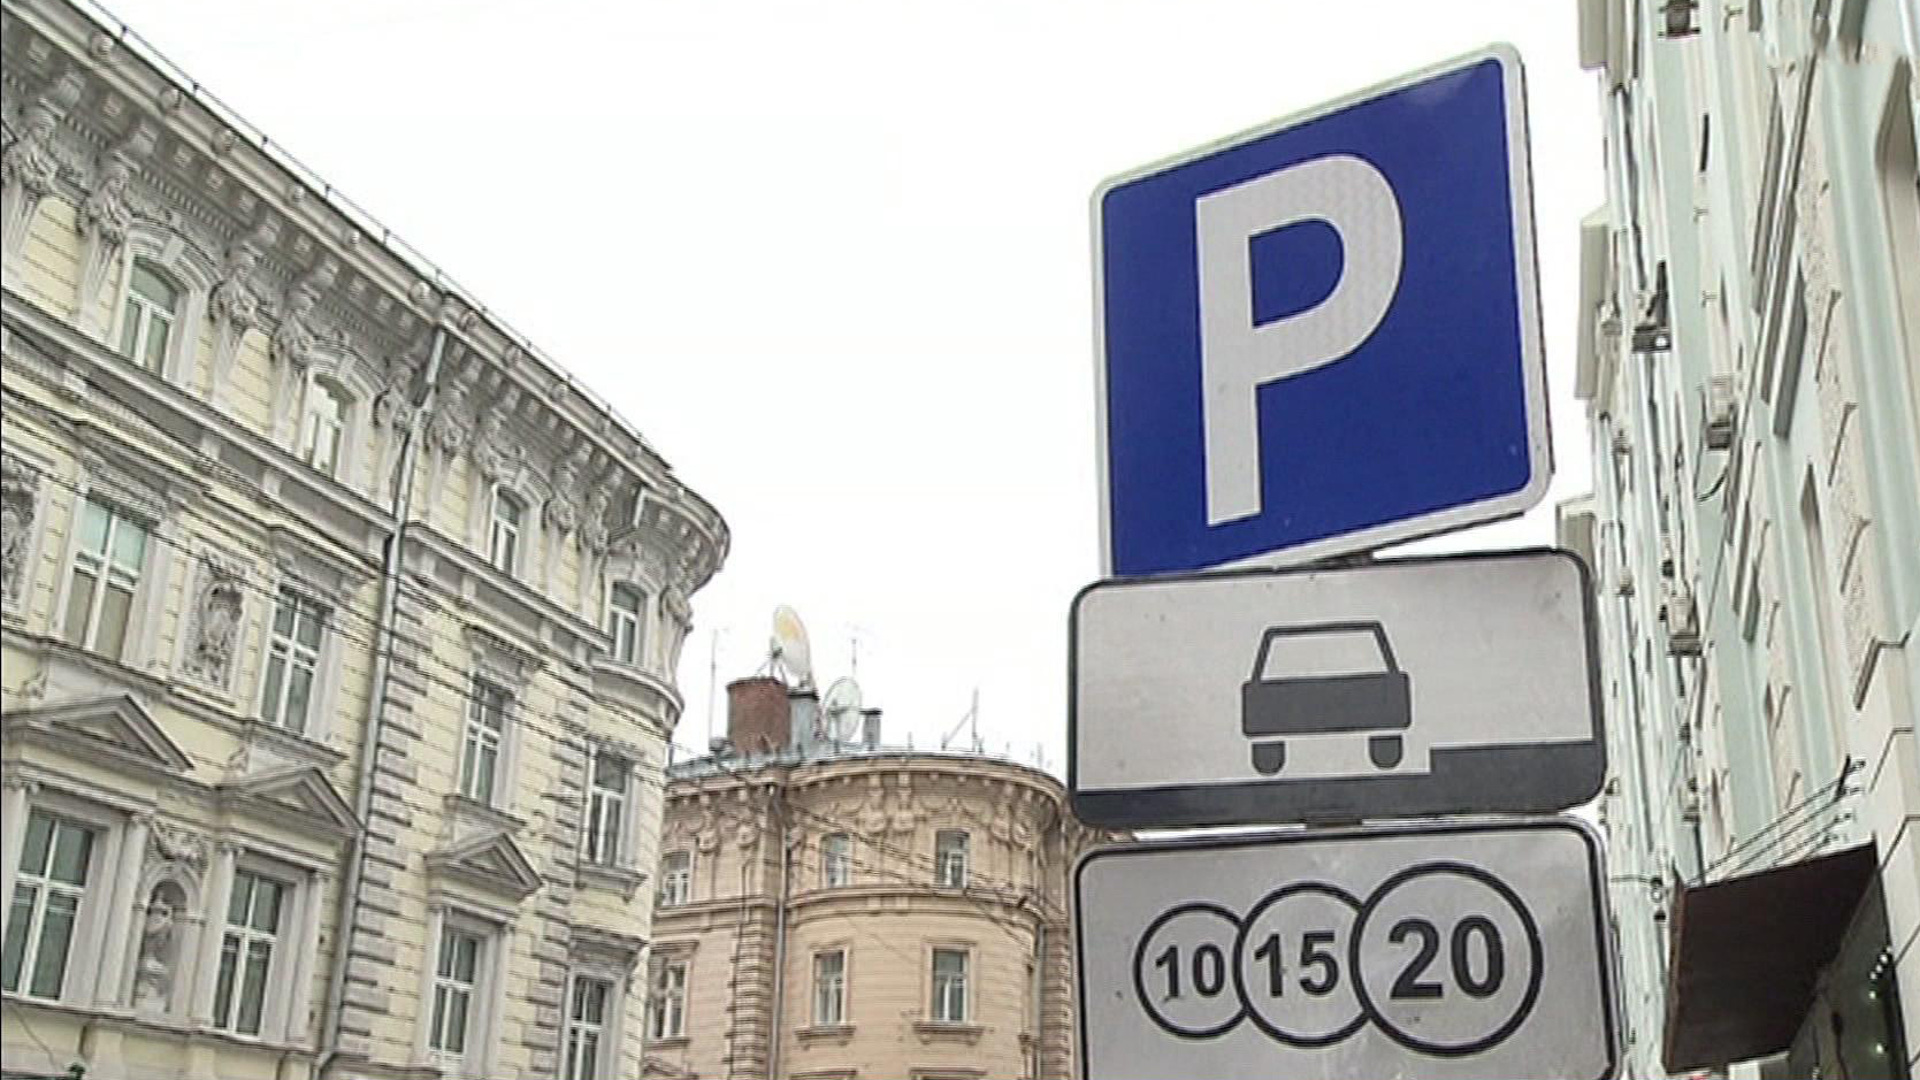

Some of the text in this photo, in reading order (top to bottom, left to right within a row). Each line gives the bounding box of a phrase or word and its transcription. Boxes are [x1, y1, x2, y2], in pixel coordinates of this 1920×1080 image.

[1195, 154, 1403, 527] P
[1155, 916, 1505, 1001] 10 15 20
